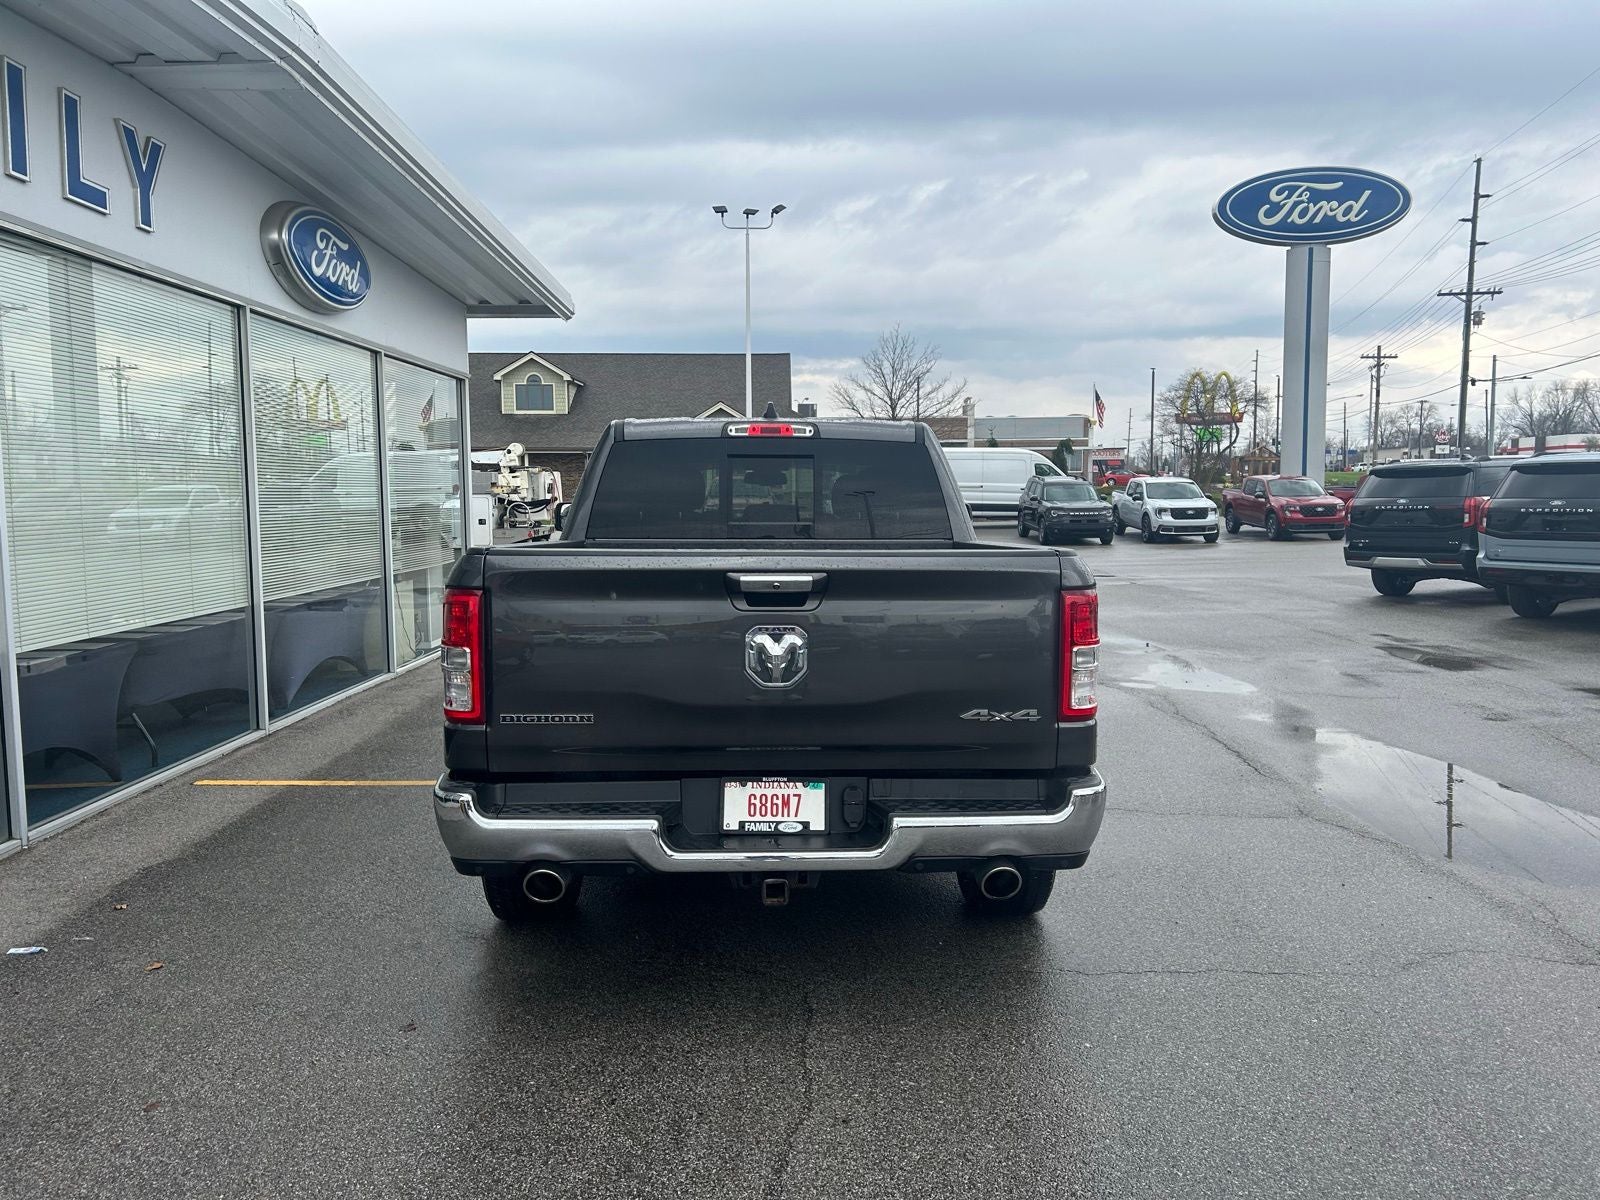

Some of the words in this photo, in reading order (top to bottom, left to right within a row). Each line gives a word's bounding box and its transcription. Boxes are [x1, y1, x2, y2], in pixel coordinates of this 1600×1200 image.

[1258, 182, 1373, 225] Ford
[311, 228, 360, 293] Ford
[500, 714, 594, 724] BIGHORN
[747, 793, 802, 818] 686M7
[745, 822, 777, 832] FAMILY
